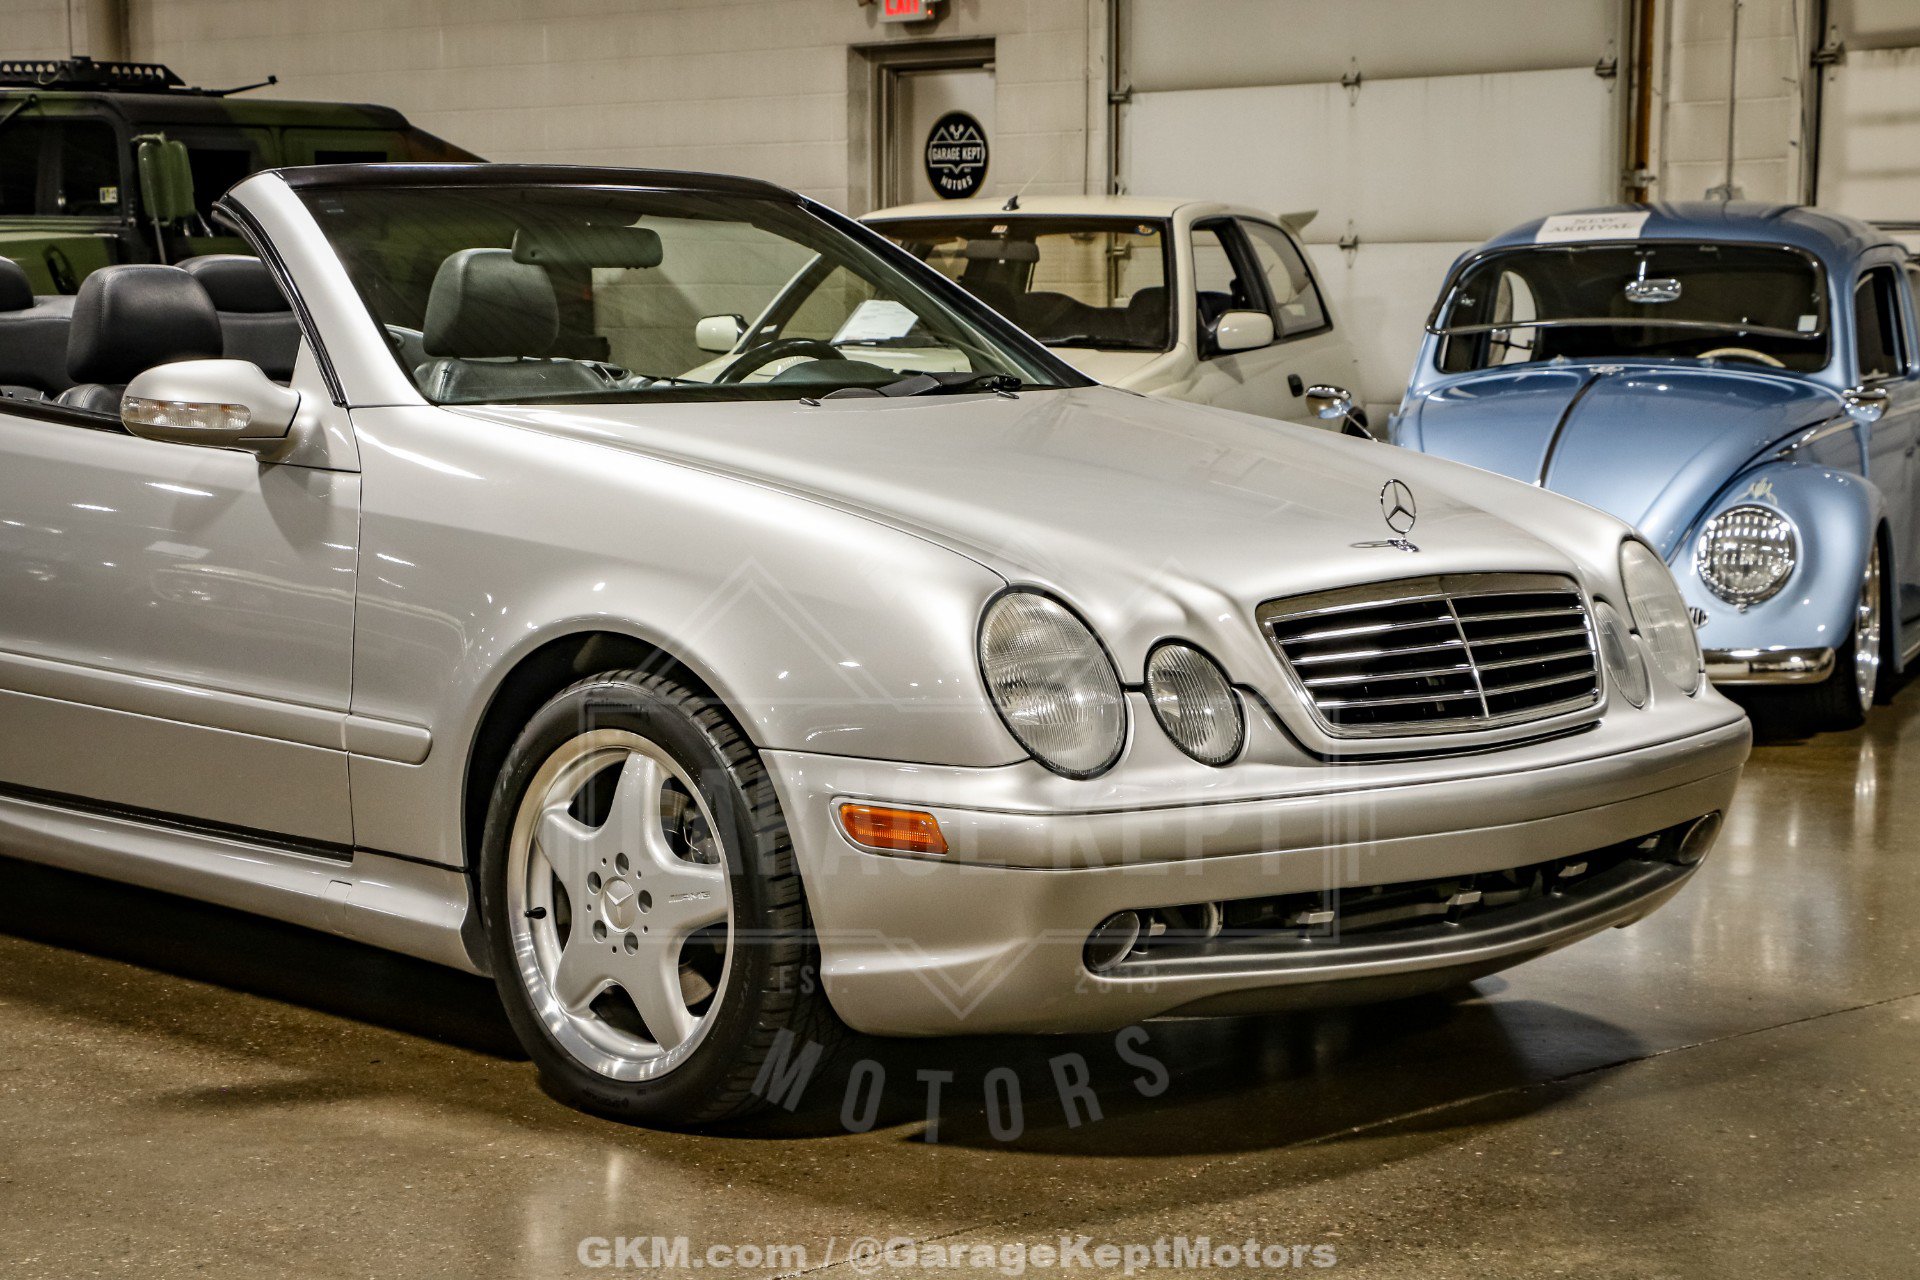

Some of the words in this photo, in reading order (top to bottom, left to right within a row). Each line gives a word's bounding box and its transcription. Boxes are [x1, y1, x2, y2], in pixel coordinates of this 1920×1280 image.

[932, 147, 960, 160] GARAGE
[962, 147, 981, 160] KEPT
[941, 175, 973, 190] MOTORS
